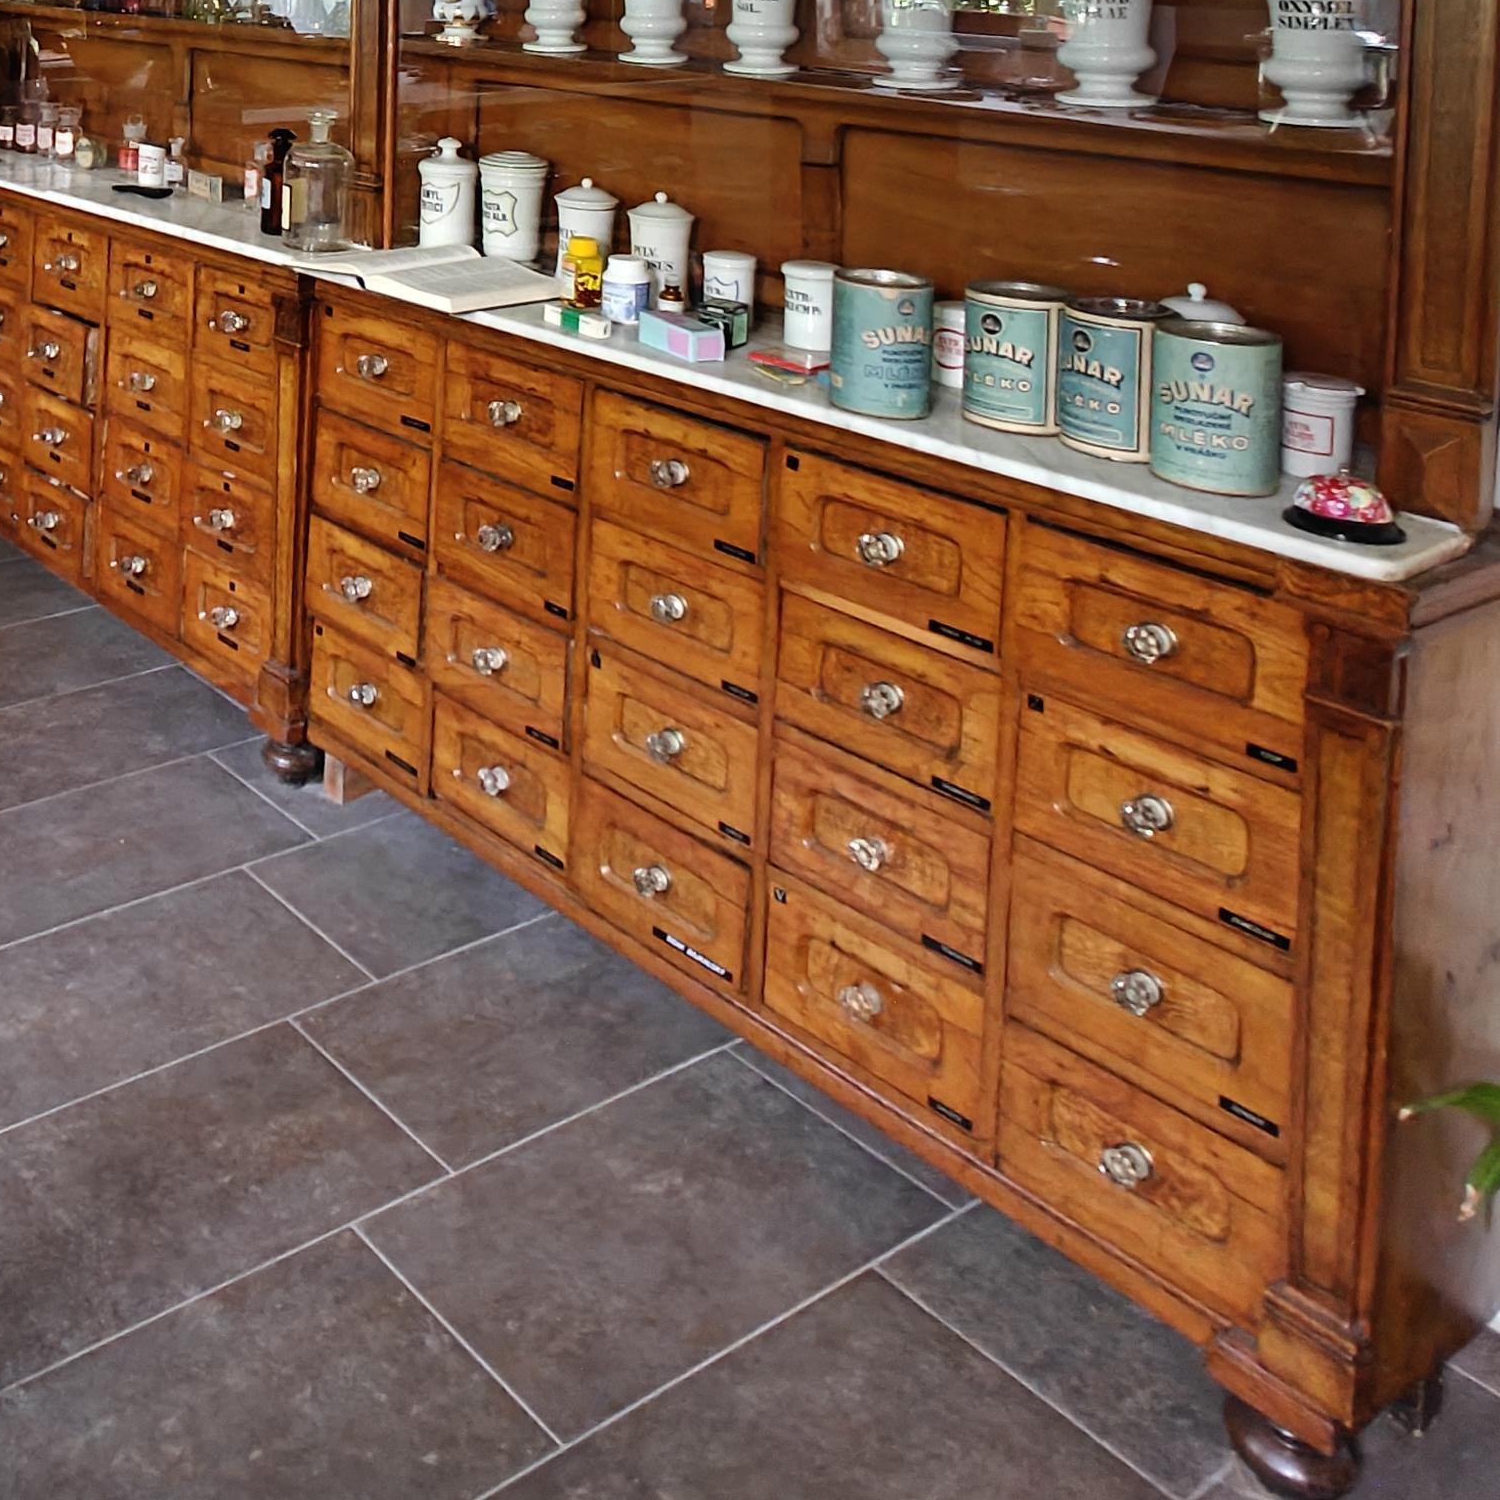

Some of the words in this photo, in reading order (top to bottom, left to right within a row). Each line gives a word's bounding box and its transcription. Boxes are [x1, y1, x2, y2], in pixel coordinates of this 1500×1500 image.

[1278, 0, 1356, 14] OXYMEL
[972, 372, 1033, 393] LÉKO
[1159, 380, 1254, 418] SUNAR
[1160, 422, 1250, 451] MLÉKO
